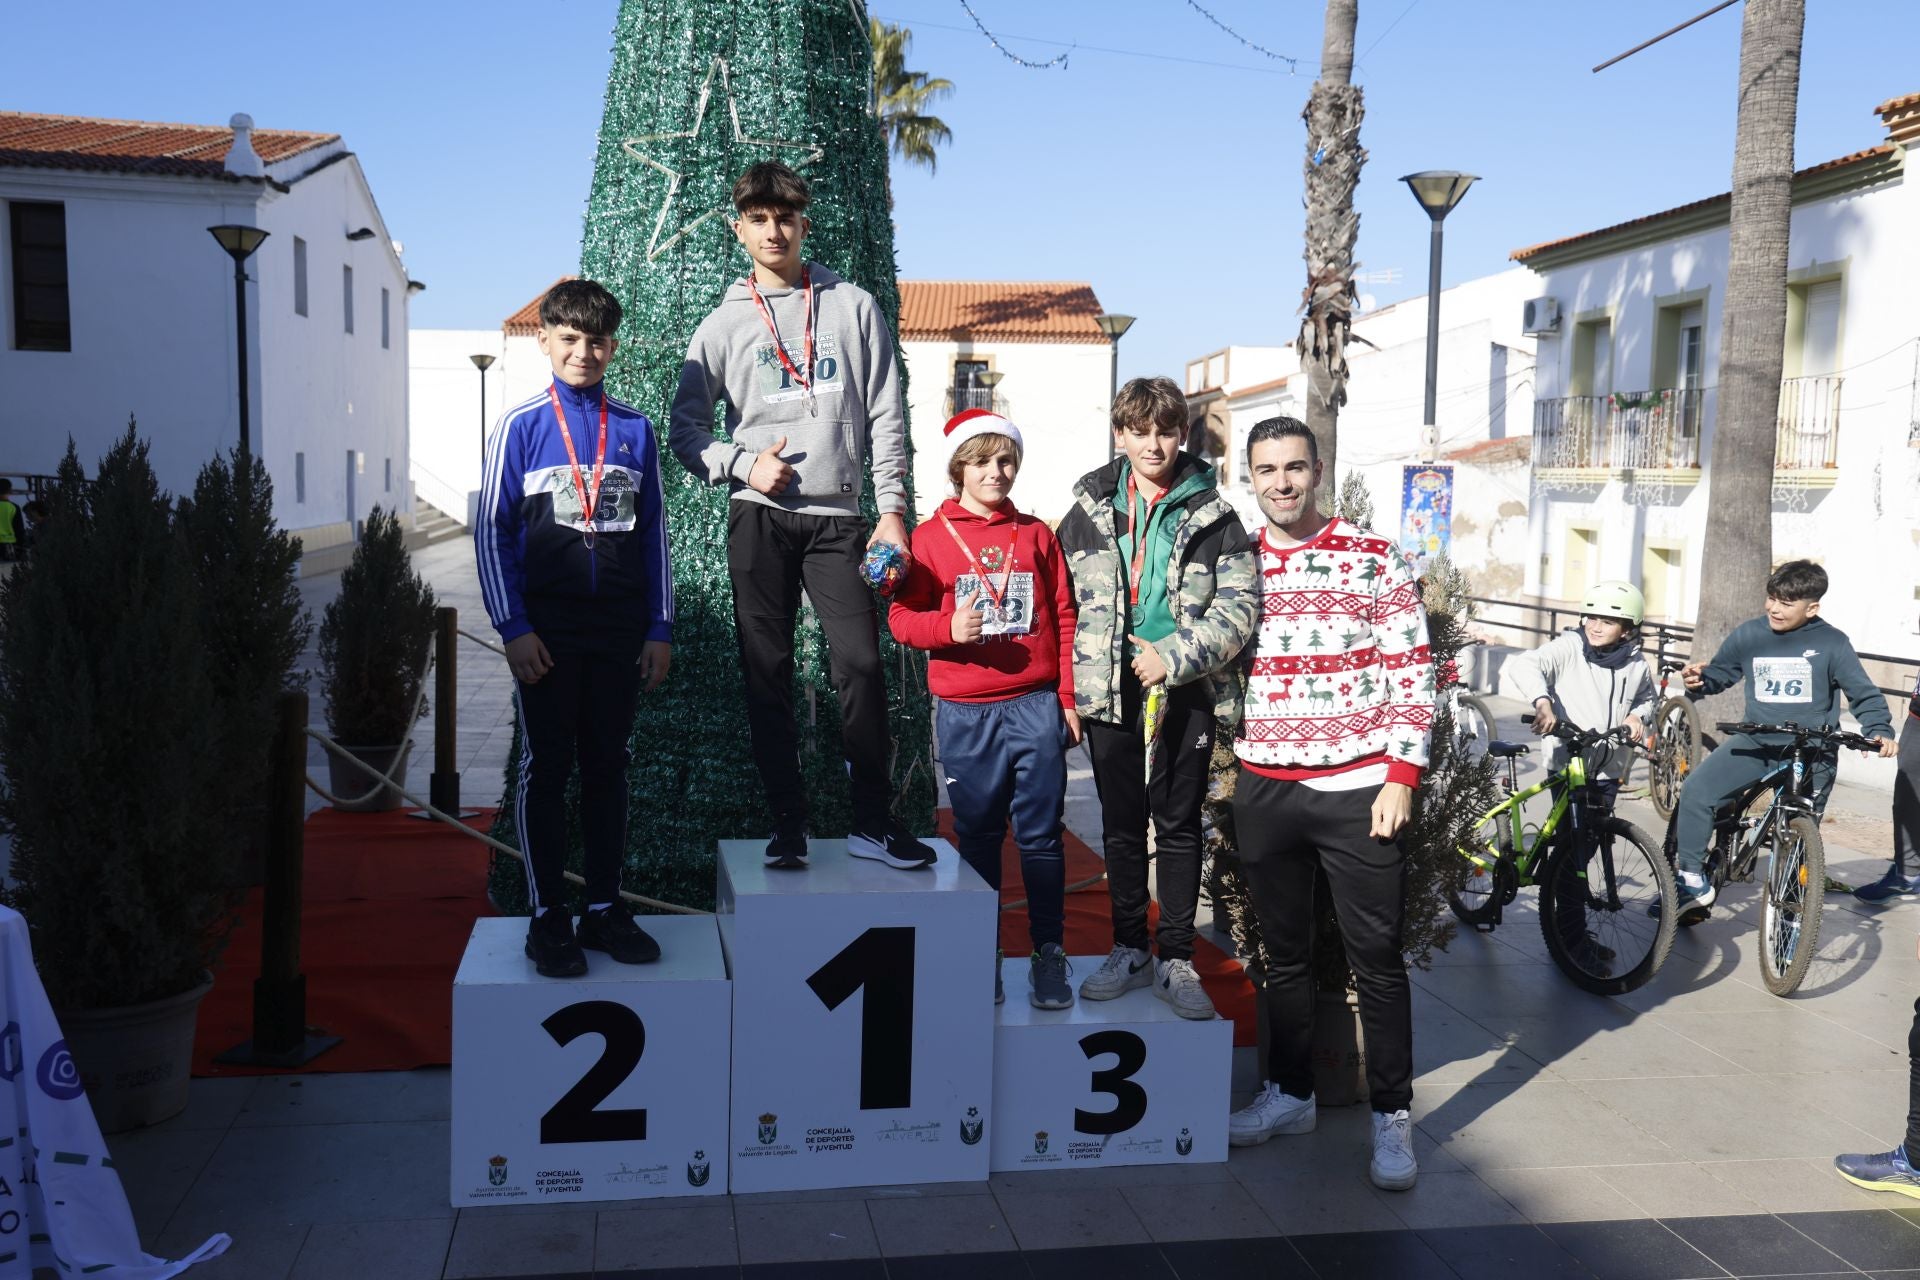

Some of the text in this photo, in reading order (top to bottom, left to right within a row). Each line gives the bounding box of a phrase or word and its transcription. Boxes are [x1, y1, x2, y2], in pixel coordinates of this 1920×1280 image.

[778, 357, 838, 390] 10
[1764, 679, 1803, 697] 46
[805, 926, 916, 1110] 1
[540, 1000, 647, 1144] 2
[1074, 1030, 1147, 1135] 3
[806, 1126, 852, 1136] CONCEJALÍA
[817, 1135, 855, 1143] DEPORTES
[816, 1144, 853, 1153] JUVENTUD
[536, 1168, 581, 1178] CONCEJALÍA
[546, 1177, 584, 1185] DEPORTES
[546, 1185, 582, 1195] JUVENTUD
